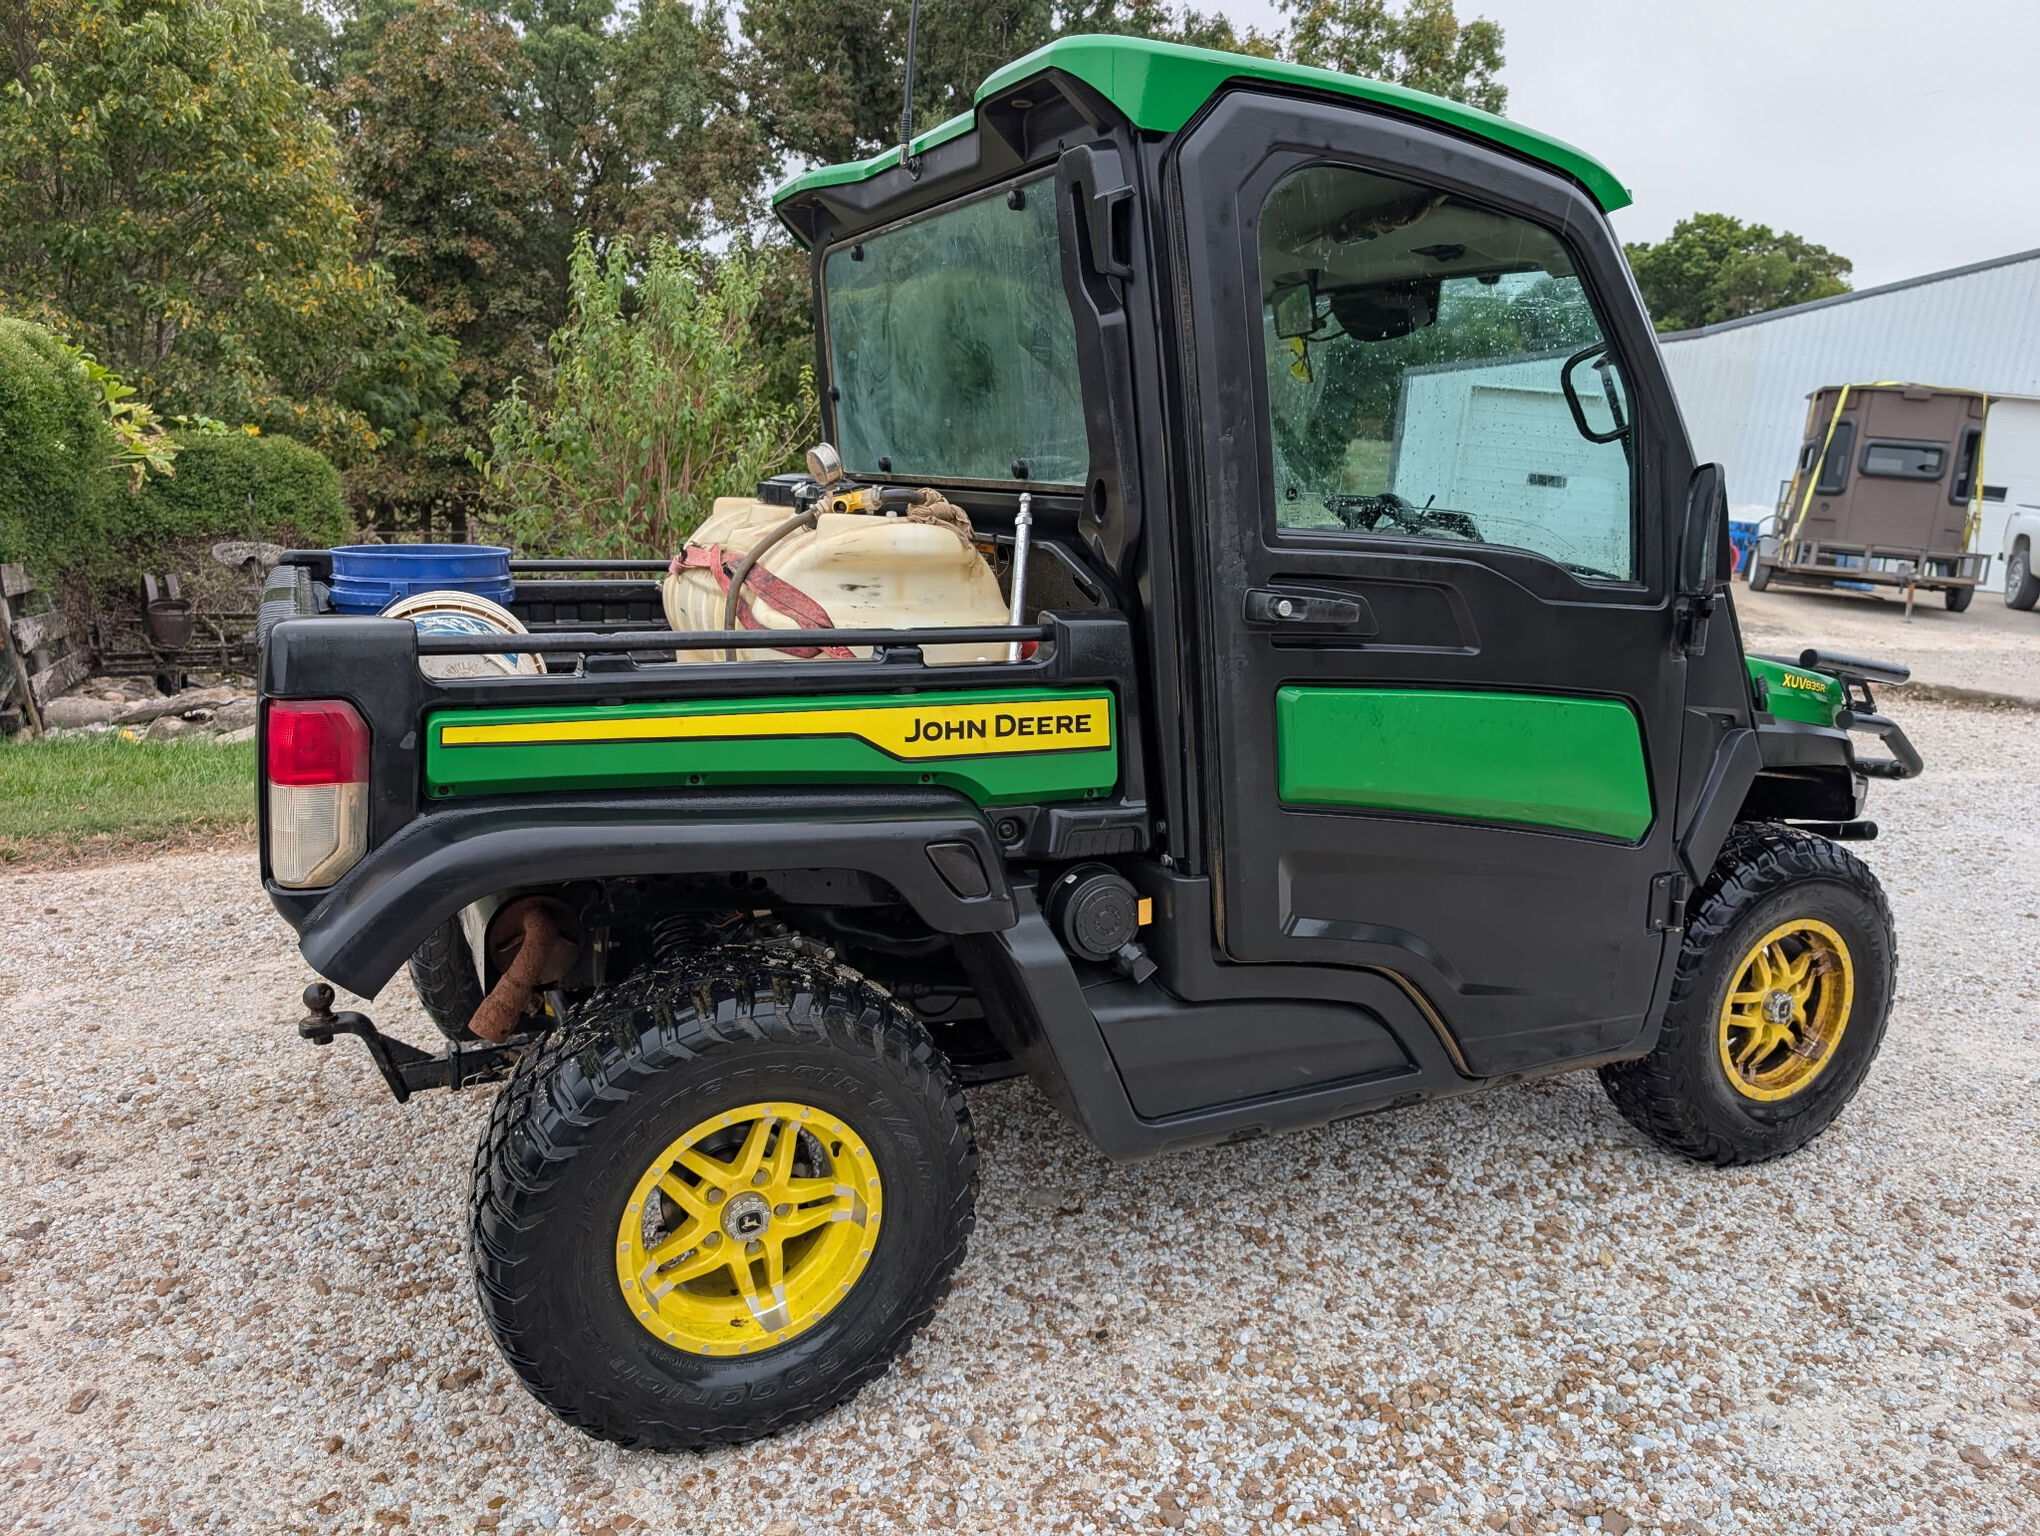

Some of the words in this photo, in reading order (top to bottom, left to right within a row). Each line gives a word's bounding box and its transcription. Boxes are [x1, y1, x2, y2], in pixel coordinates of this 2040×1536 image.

[1782, 673, 1827, 693] XUV835R
[904, 718, 986, 743] JOHN
[995, 713, 1092, 737] DEERE
